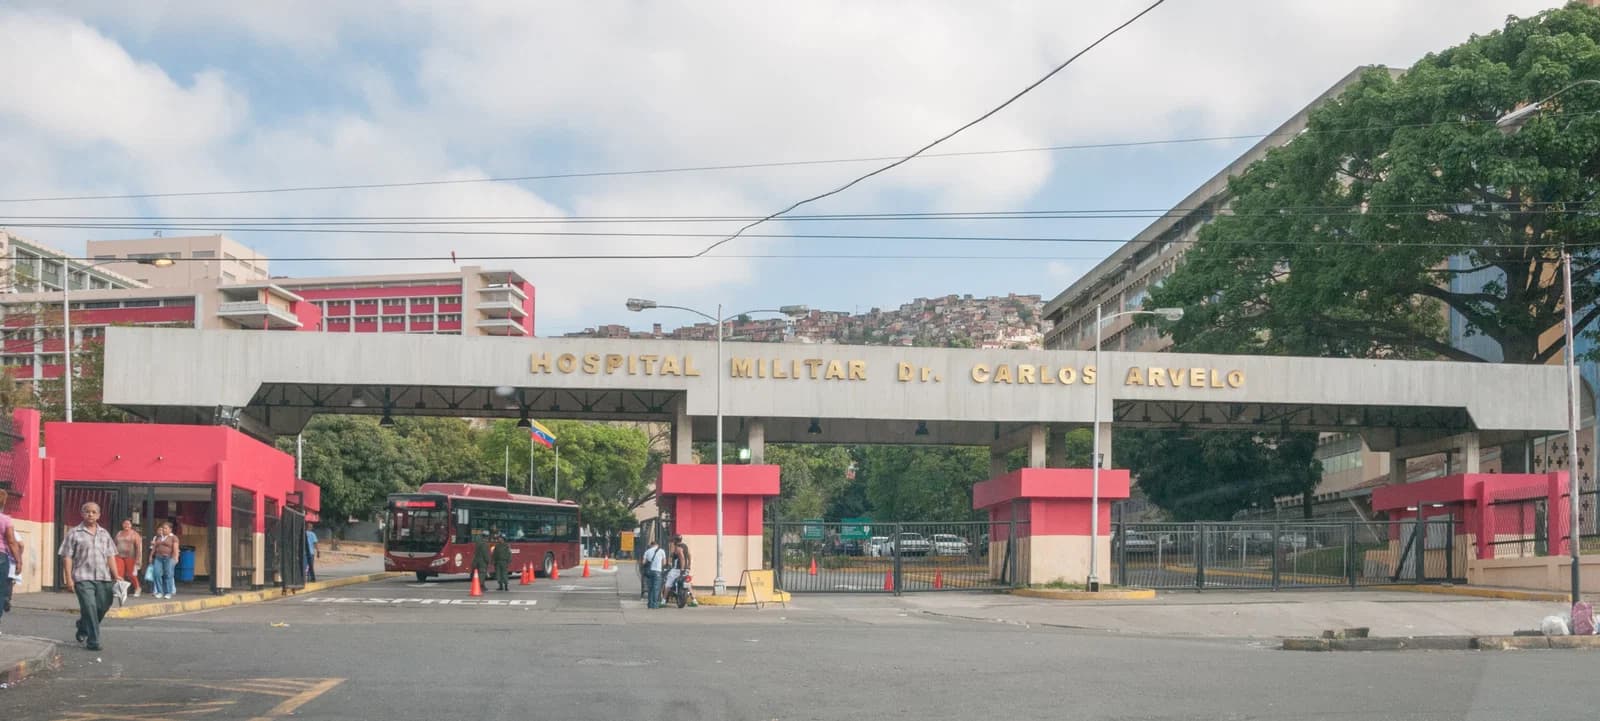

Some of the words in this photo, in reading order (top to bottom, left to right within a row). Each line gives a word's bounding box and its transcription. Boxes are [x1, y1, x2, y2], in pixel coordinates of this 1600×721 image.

[530, 352, 701, 377] HOSPITAL
[730, 357, 868, 381] MILITAR
[897, 361, 941, 382] Dr.
[970, 363, 1097, 385] CARLOS
[1124, 366, 1246, 388] ARVELO
